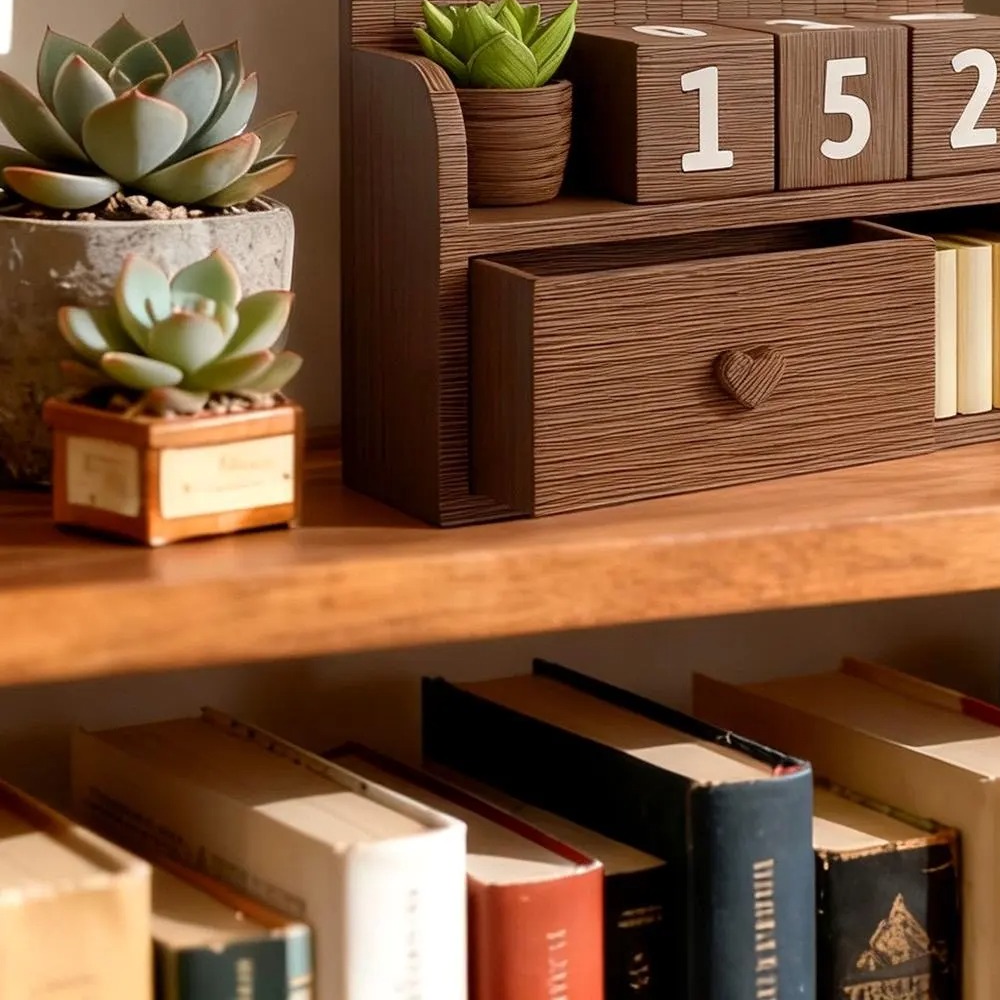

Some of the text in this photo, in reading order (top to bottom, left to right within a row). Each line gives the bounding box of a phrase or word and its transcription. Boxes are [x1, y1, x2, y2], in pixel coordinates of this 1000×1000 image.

[680, 48, 998, 172] 1 5 2
